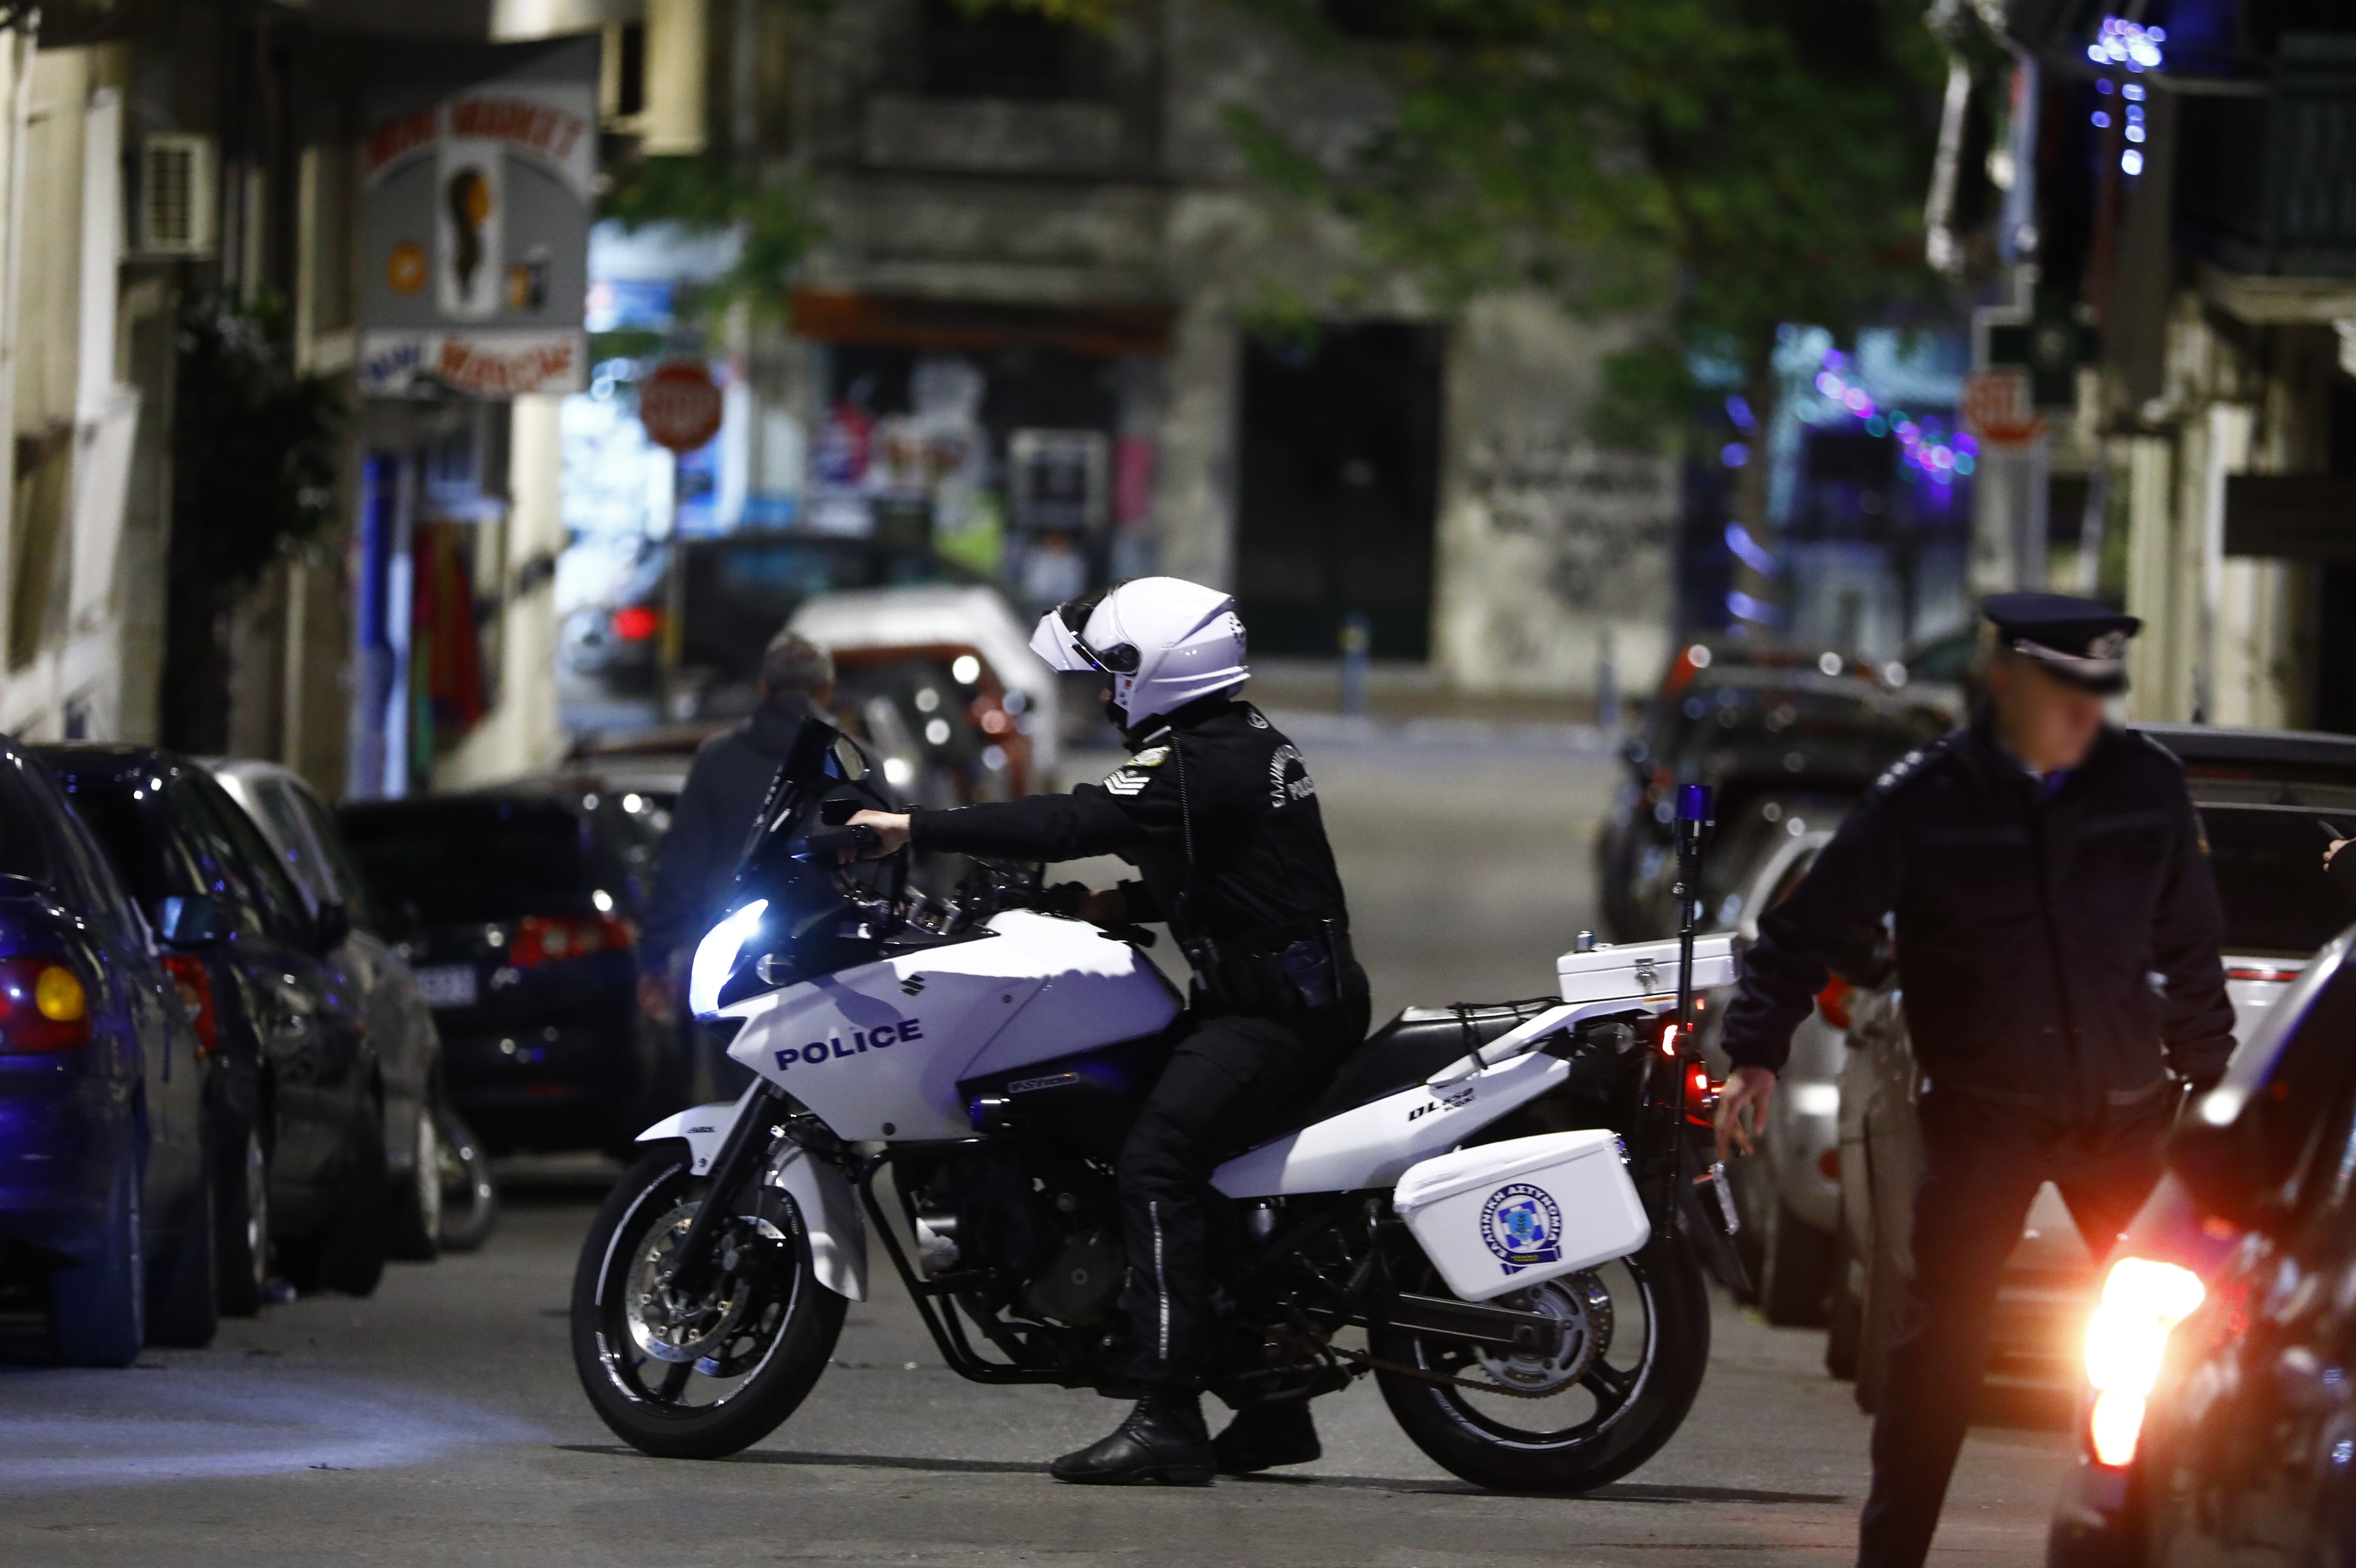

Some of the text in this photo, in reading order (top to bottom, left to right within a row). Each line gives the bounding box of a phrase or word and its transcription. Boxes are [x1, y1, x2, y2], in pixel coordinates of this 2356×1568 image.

[775, 1019, 923, 1071] POLICE
[1481, 1185, 1561, 1257] ΕΛΛΗΝΙΚΗ ΑΣΤΥΝΟΜΙΑ
